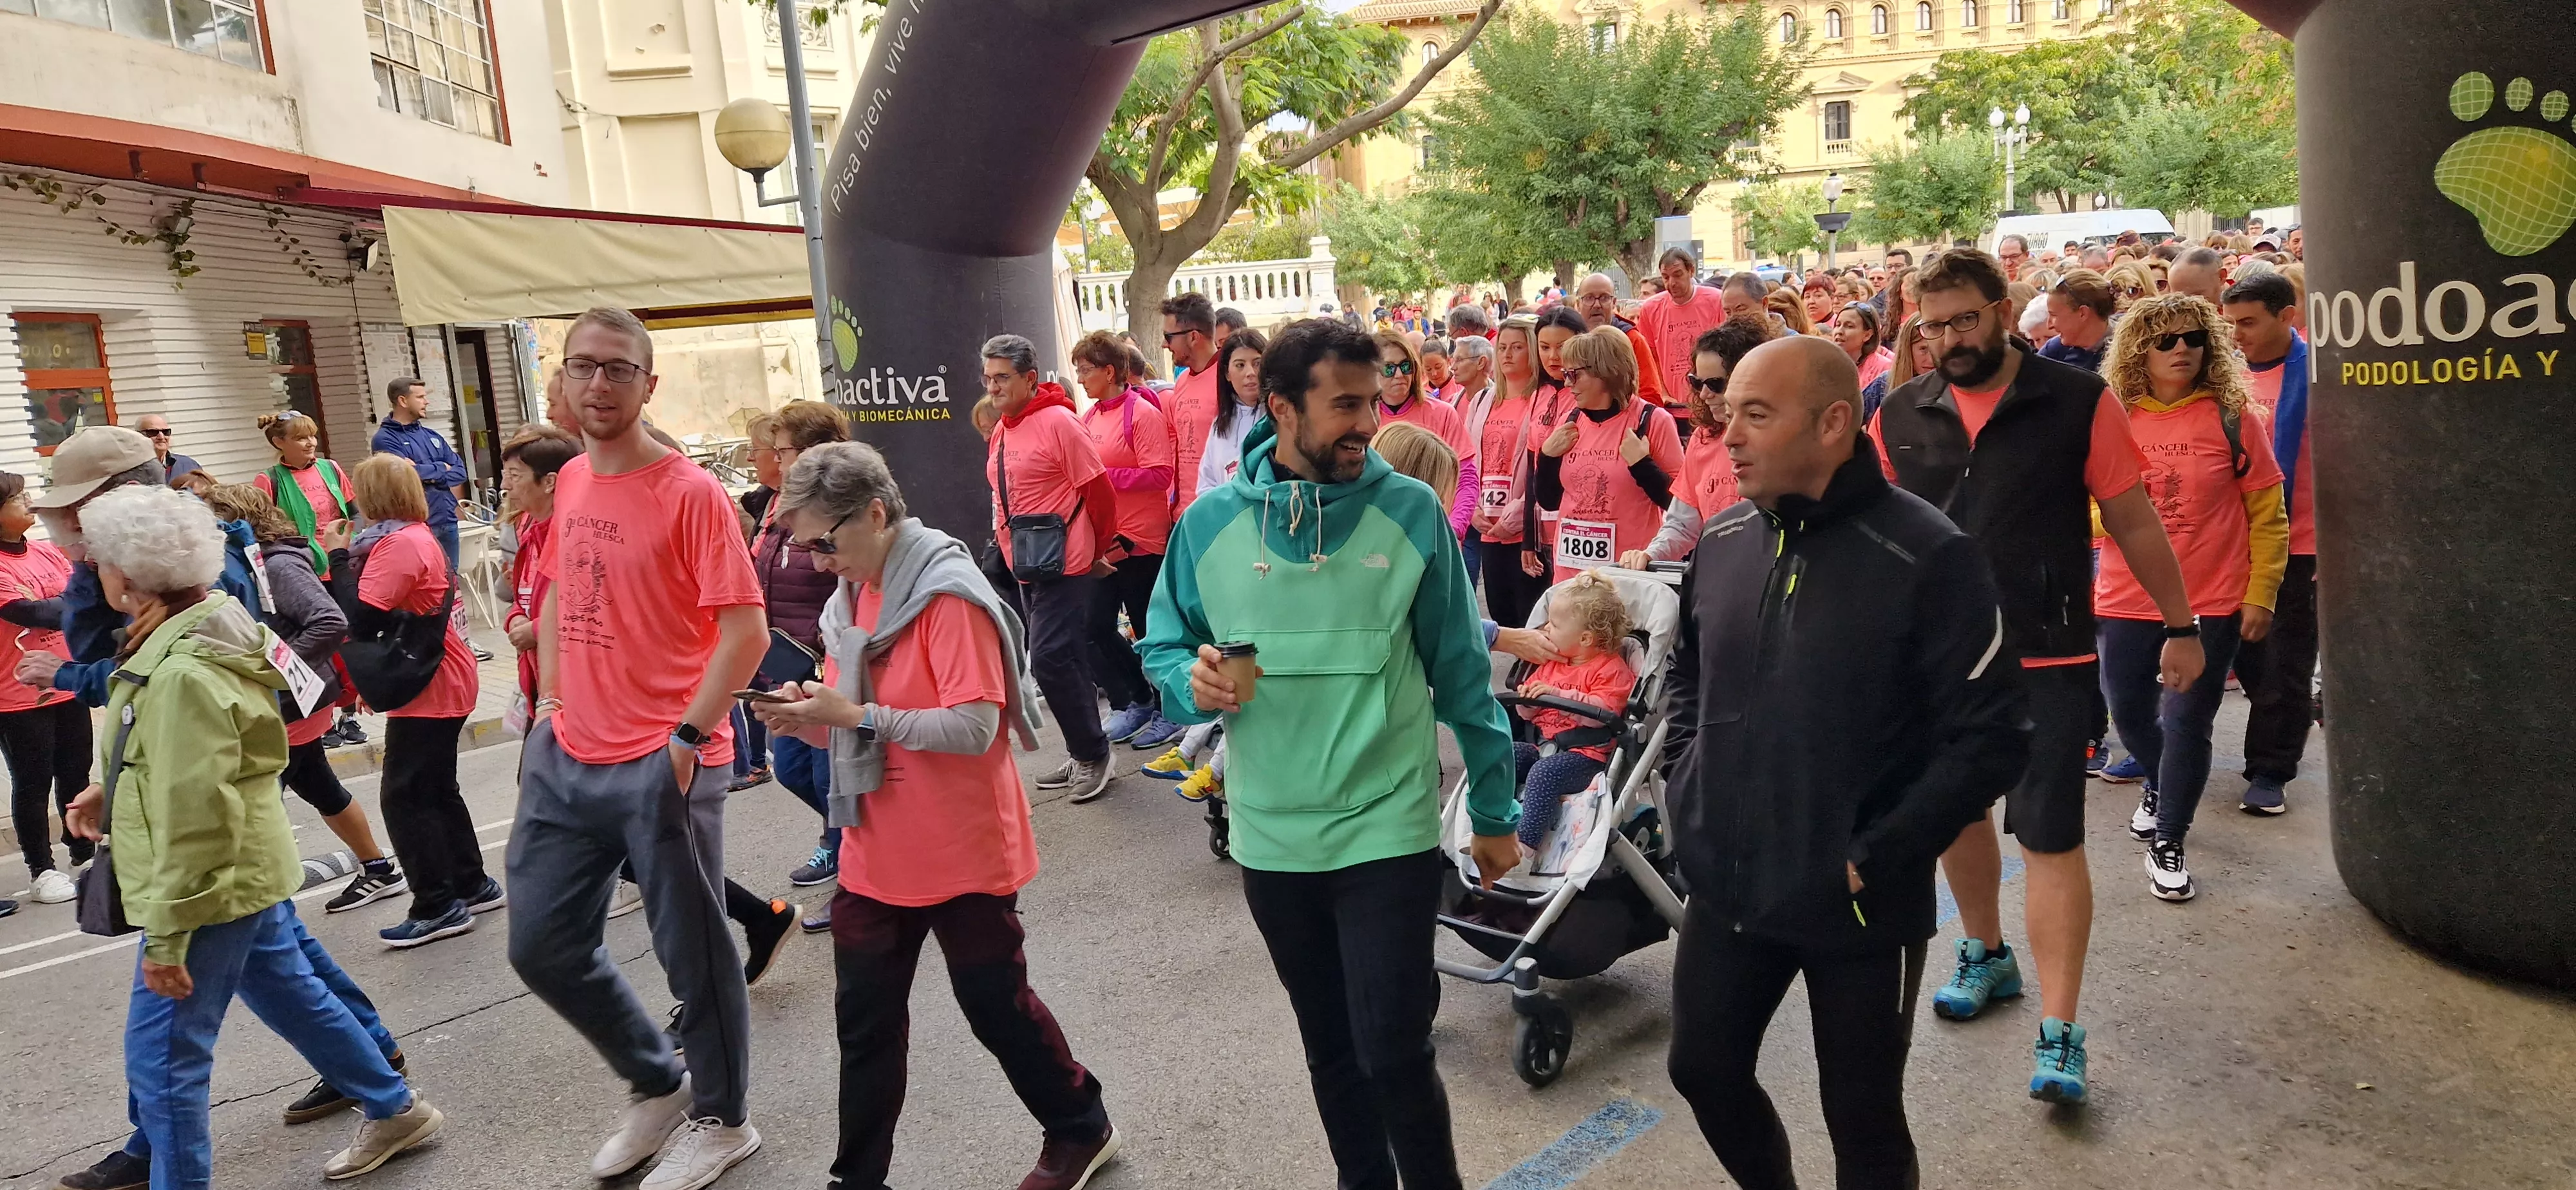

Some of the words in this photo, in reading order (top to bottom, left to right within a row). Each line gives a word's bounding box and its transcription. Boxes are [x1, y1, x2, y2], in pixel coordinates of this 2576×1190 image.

[831, 152, 861, 212] Pisa
[855, 88, 892, 151] bien,
[885, 17, 913, 75] vive
[2309, 261, 2576, 384] podoa
[2342, 348, 2522, 386] PODOLOGÍA
[2536, 350, 2560, 376] Y
[851, 410, 857, 422] Y
[859, 406, 951, 422] BIOMECÁNICA
[1582, 448, 1615, 457] CÁNCER
[2141, 442, 2188, 452] CÁNCER
[1721, 475, 1739, 485] CÁN
[577, 515, 618, 534] CÁNCER
[592, 530, 625, 545] HUESCA
[1563, 536, 1608, 558] 1808
